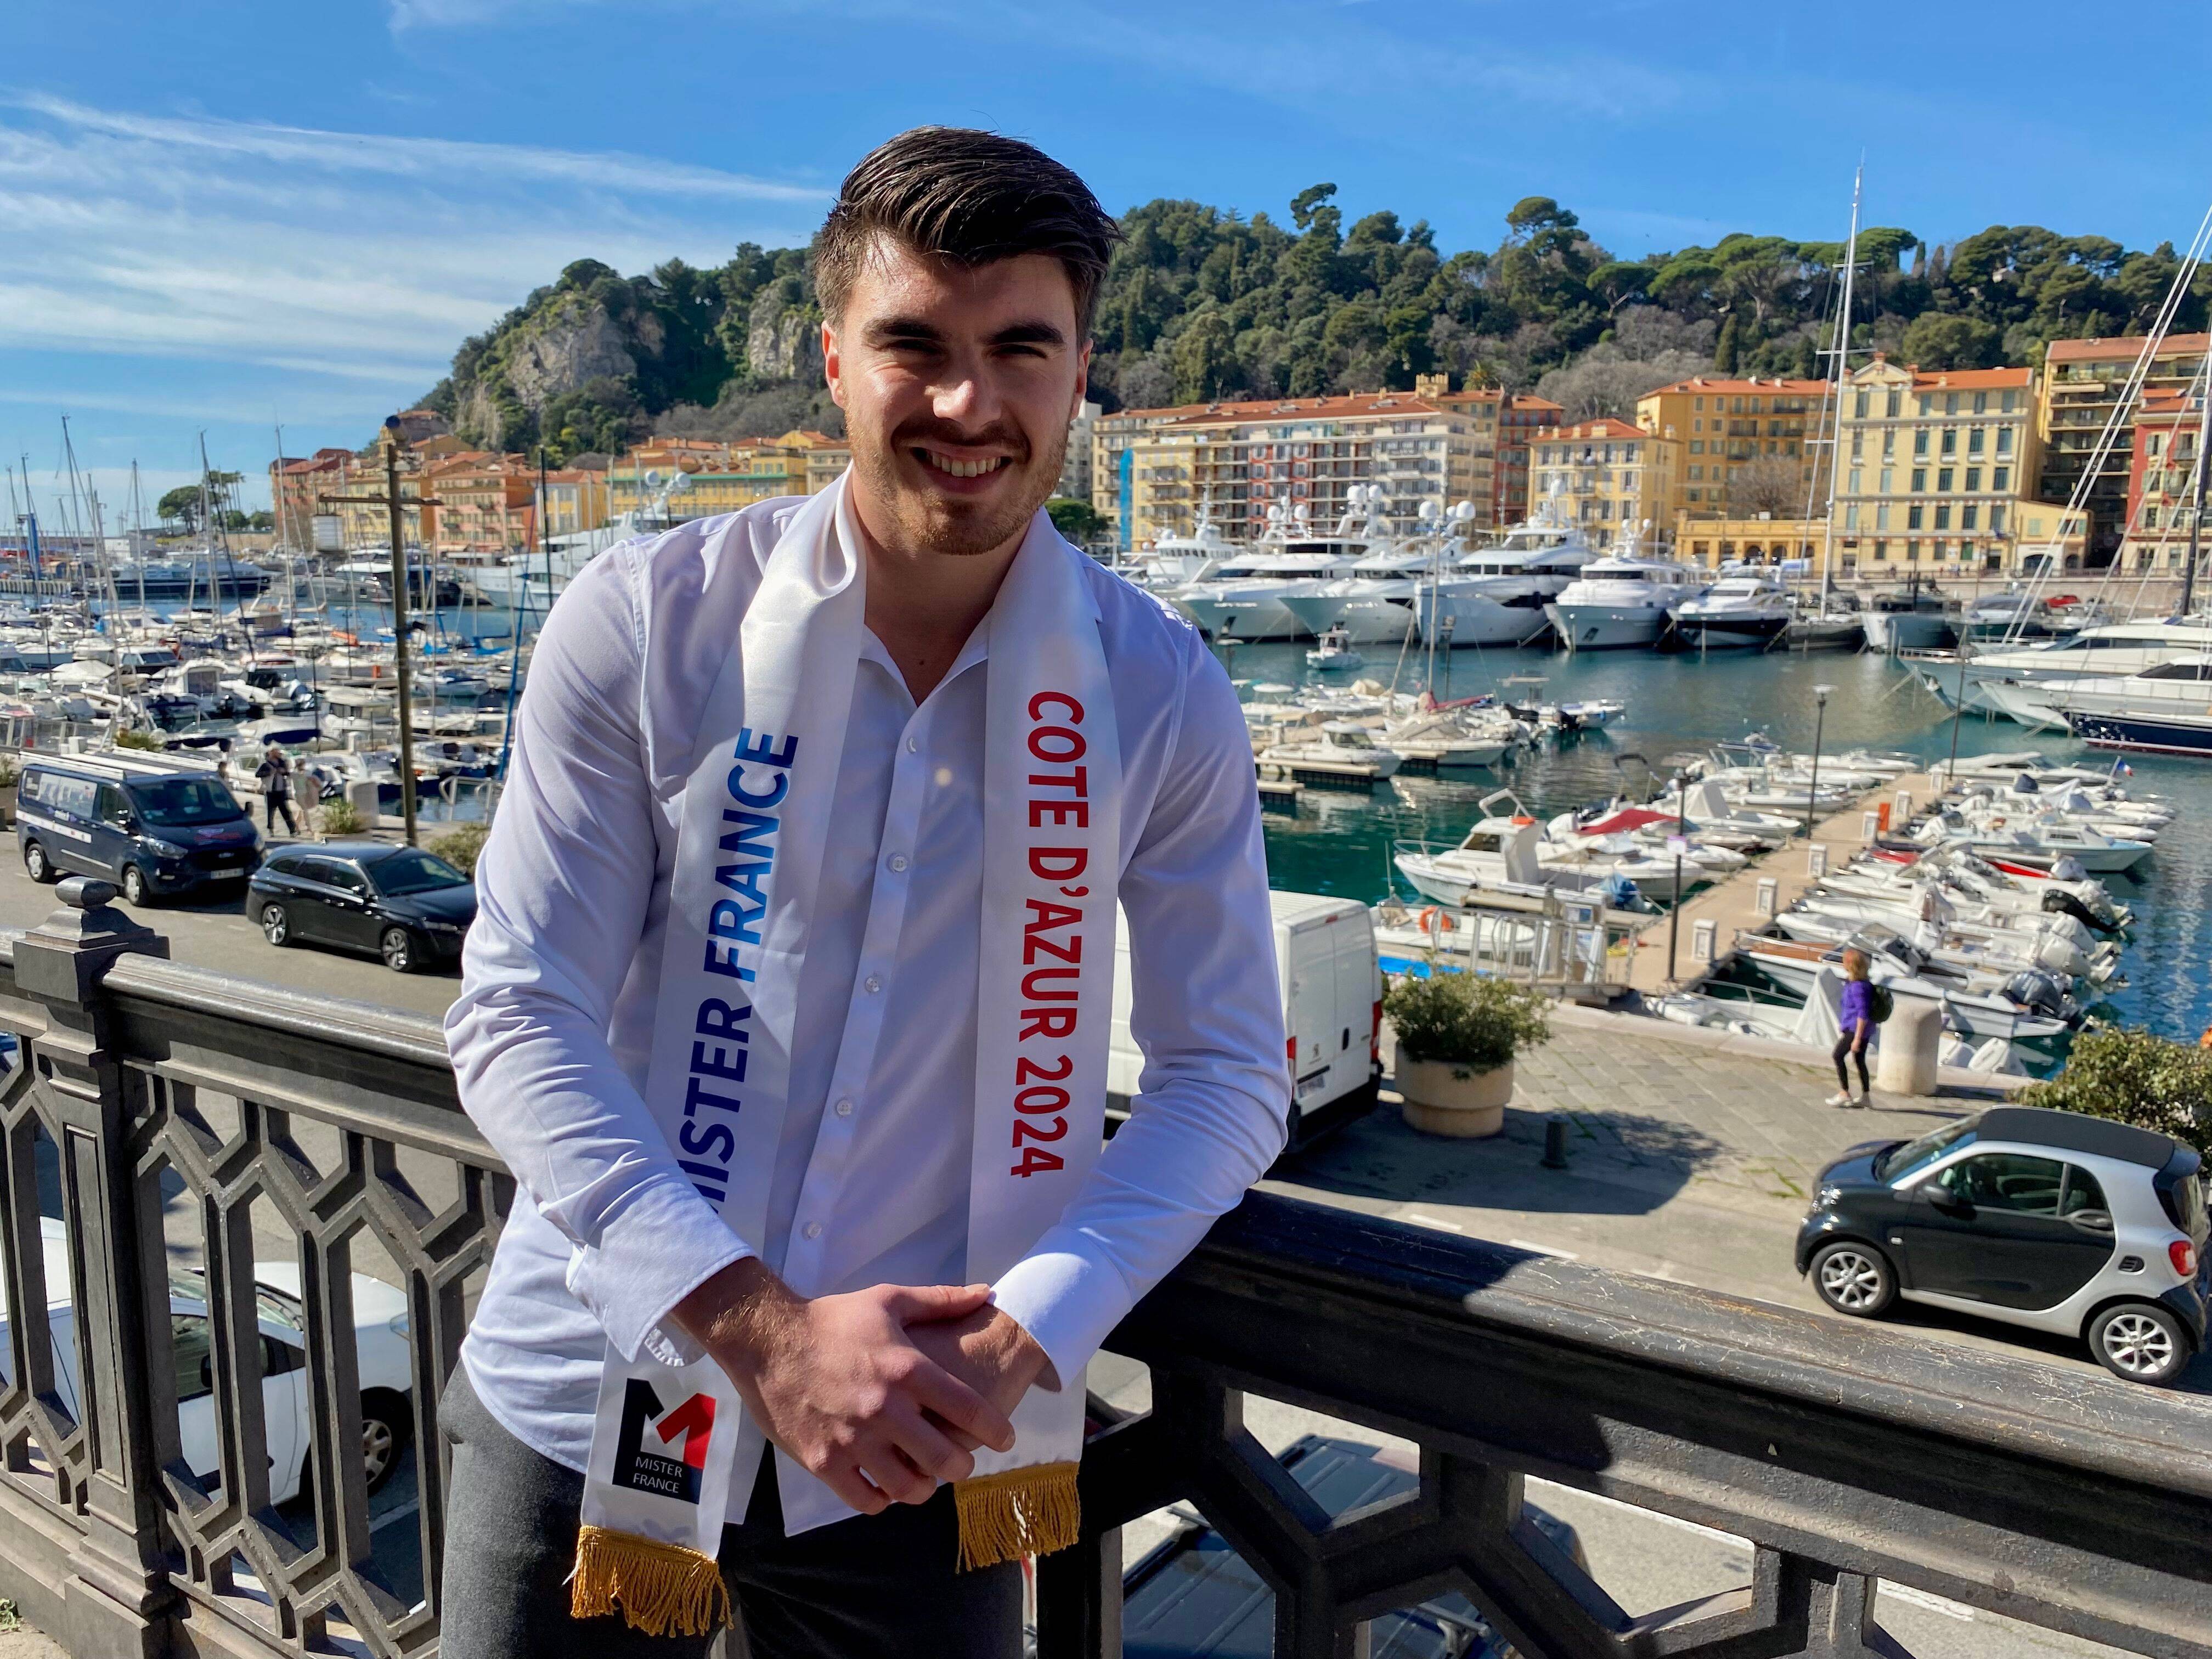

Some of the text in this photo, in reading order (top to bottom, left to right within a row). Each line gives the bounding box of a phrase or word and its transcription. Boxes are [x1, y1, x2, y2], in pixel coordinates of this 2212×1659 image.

[703, 727, 798, 983] FRANCE
[1011, 691, 1089, 1178] COTE D'AZUR 2024
[633, 1473, 680, 1493] FRANCE
[635, 1457, 682, 1477] MISTER
